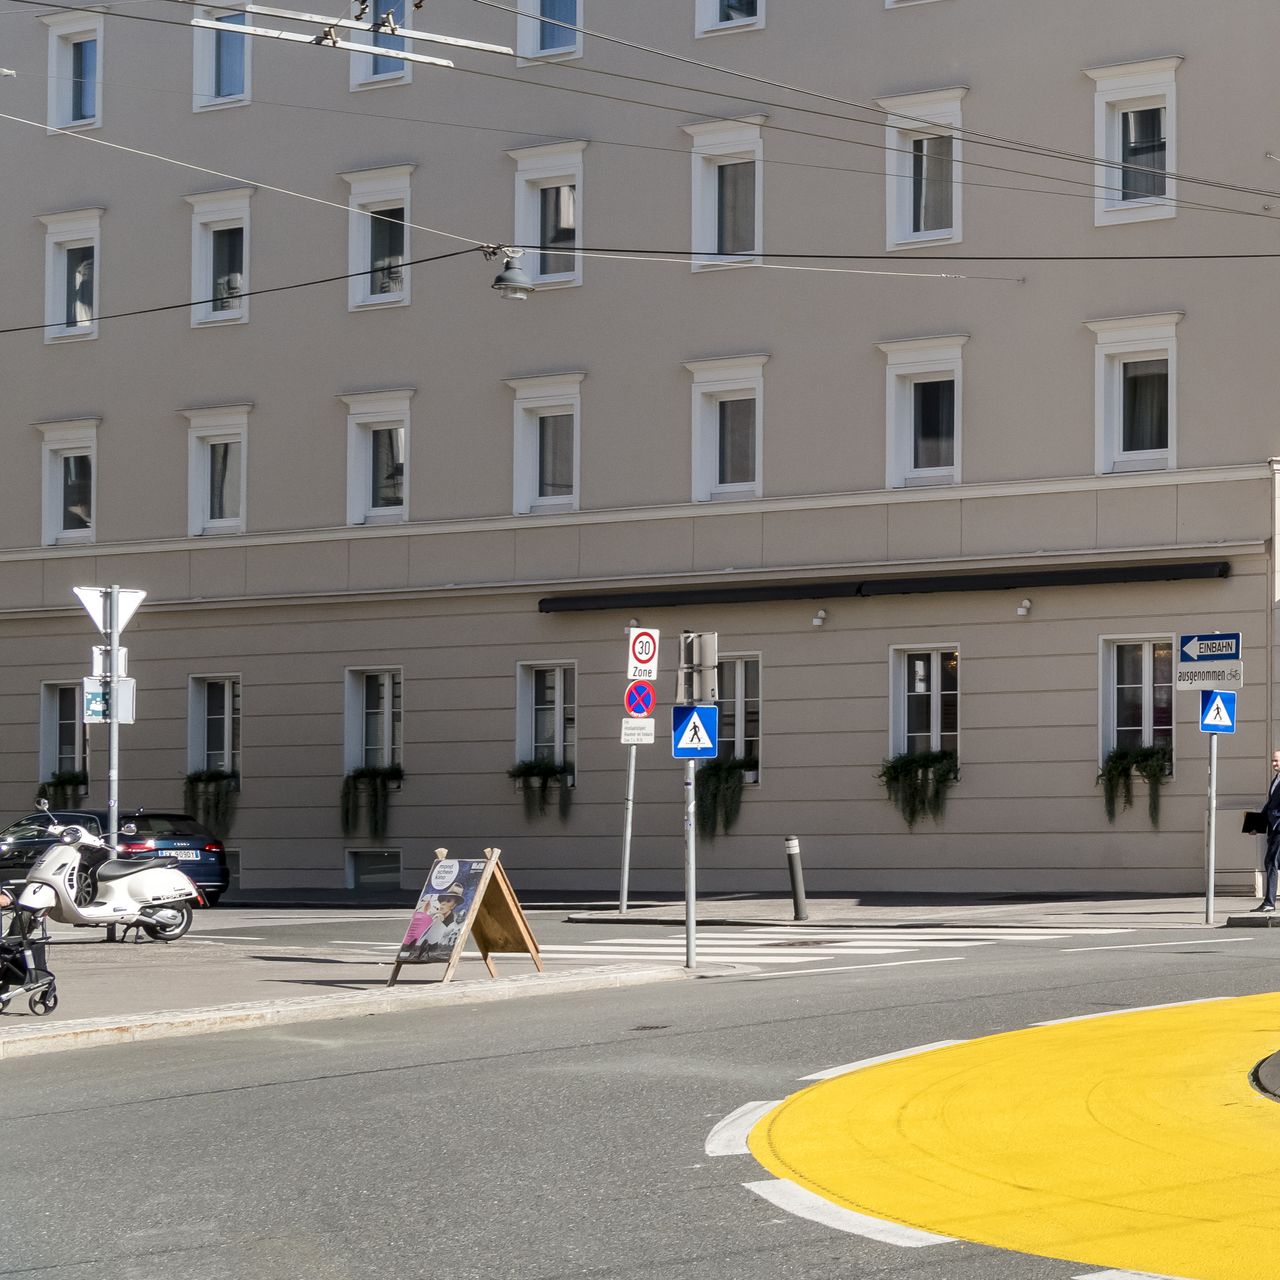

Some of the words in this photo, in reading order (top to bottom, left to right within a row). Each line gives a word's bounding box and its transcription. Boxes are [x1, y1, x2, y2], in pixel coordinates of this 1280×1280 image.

[638, 640, 651, 655] 30
[1198, 641, 1234, 654] EINBAHN
[632, 666, 653, 677] Zone
[1177, 669, 1226, 684] ausgenommen
